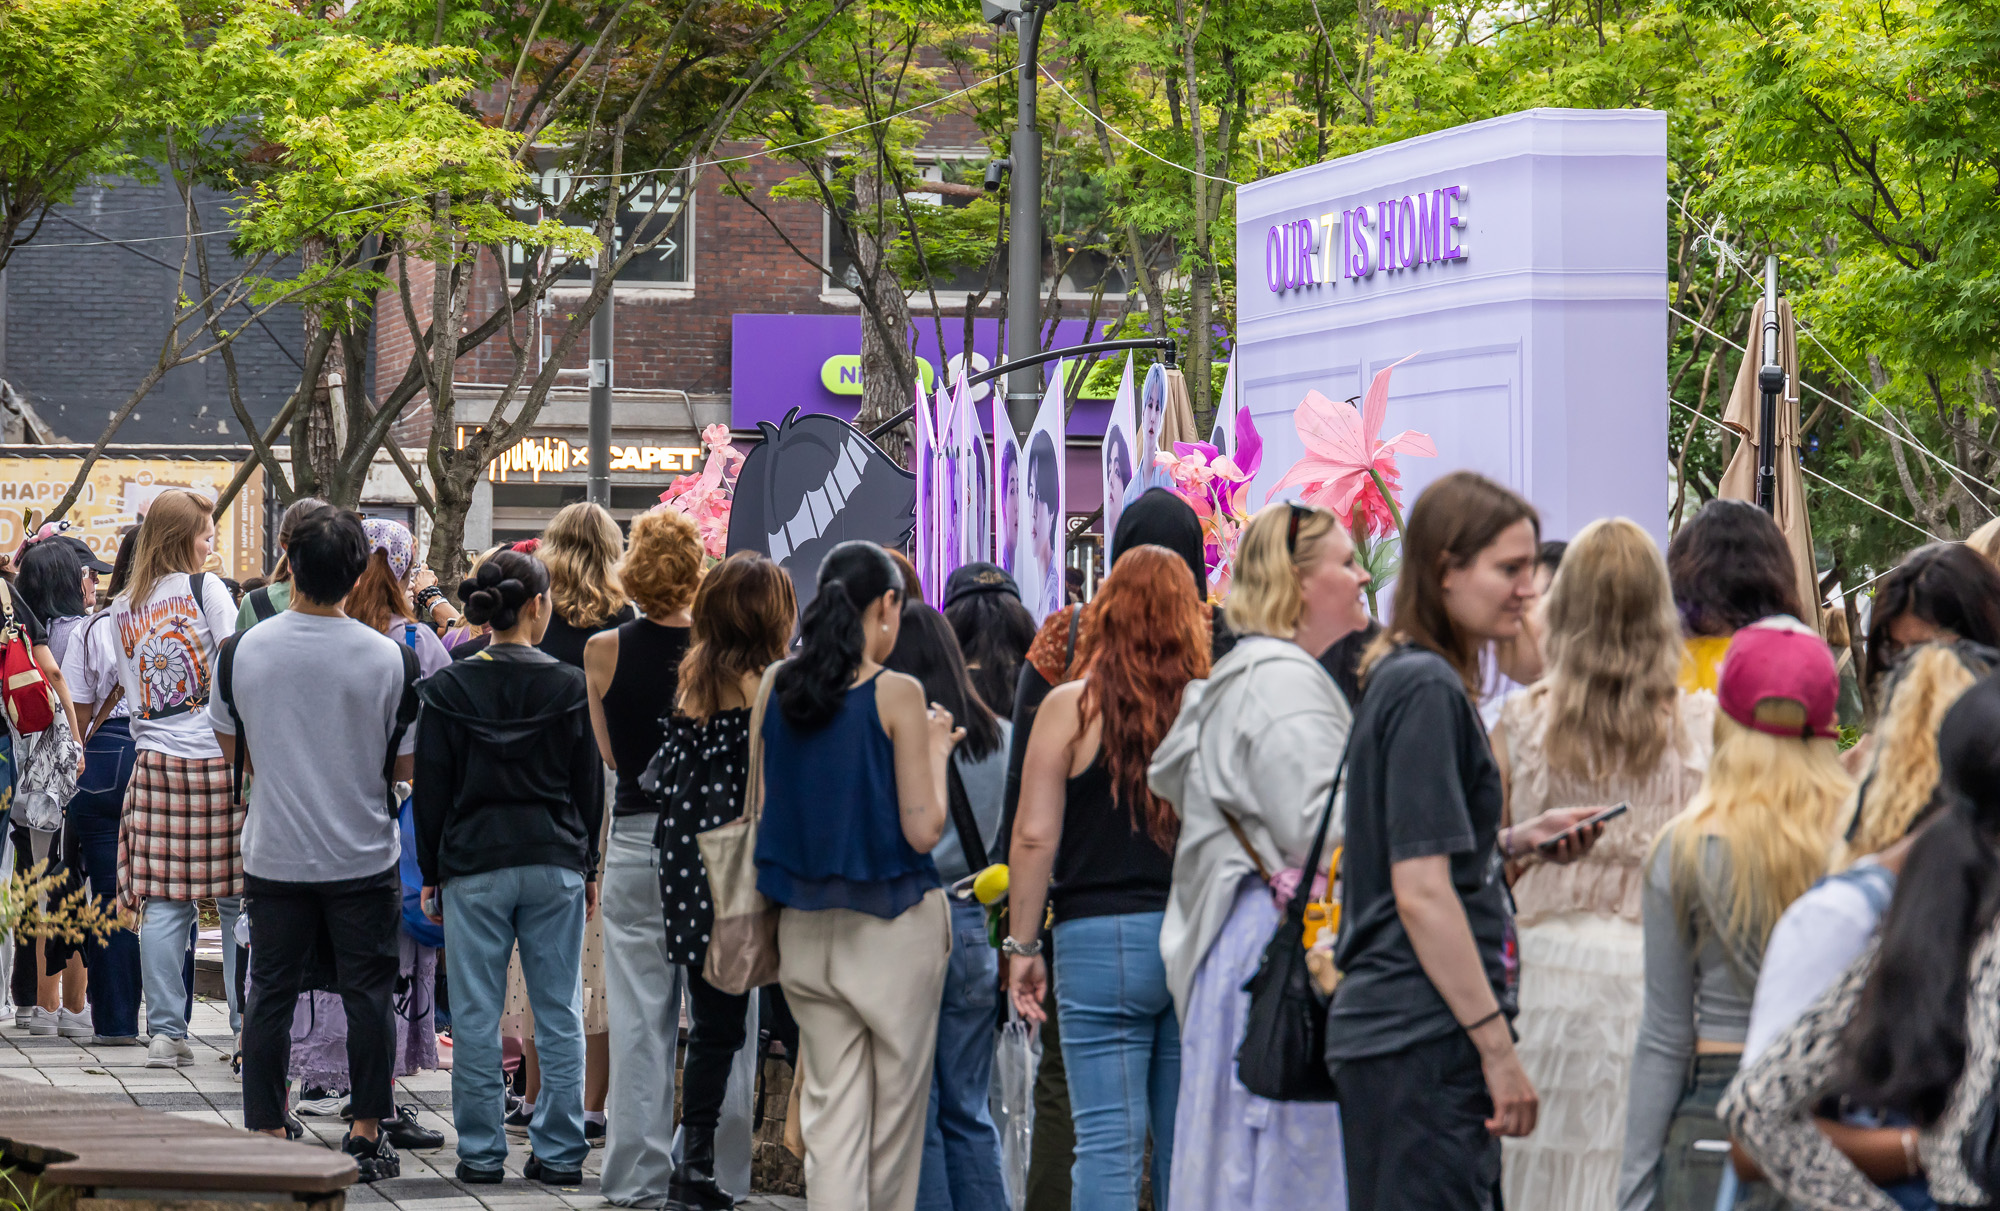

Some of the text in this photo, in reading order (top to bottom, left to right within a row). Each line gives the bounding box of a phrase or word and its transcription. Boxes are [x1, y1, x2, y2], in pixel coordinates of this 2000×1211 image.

[1266, 185, 1466, 292] OUR 7 IS HOME
[116, 596, 198, 648] SPREAD GOOD VIBES
